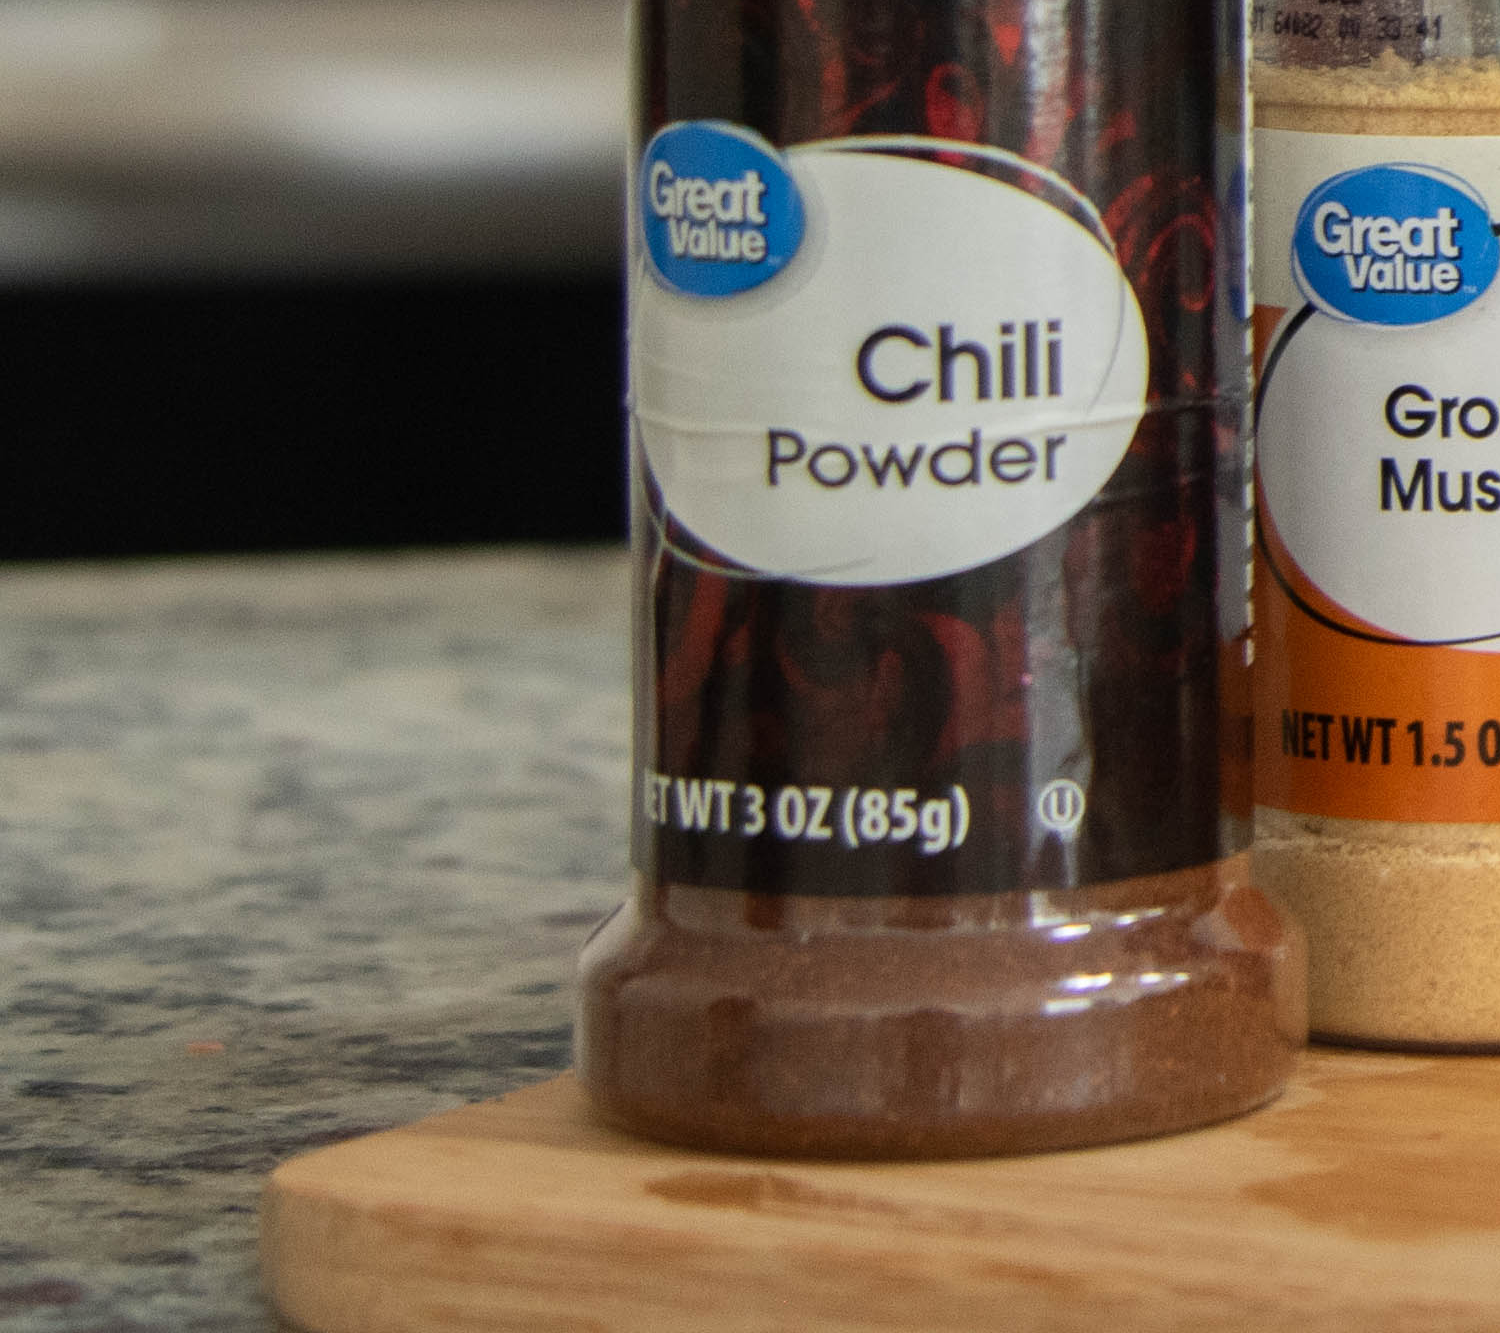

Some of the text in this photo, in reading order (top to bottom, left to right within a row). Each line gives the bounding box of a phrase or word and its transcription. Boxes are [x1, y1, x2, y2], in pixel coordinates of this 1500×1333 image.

[650, 159, 767, 224] Great
[669, 221, 767, 262] Value
[1313, 201, 1460, 260] Great
[1346, 254, 1460, 295] Value
[856, 318, 1065, 403] Chili
[766, 428, 1068, 489] Powder
[1281, 707, 1334, 761] NET
[1338, 715, 1396, 766] WT
[1406, 717, 1467, 769] 1.5
[676, 779, 736, 833] WT
[742, 783, 768, 837] 3
[777, 786, 834, 840] OZ
[841, 783, 971, 856] (85g)
